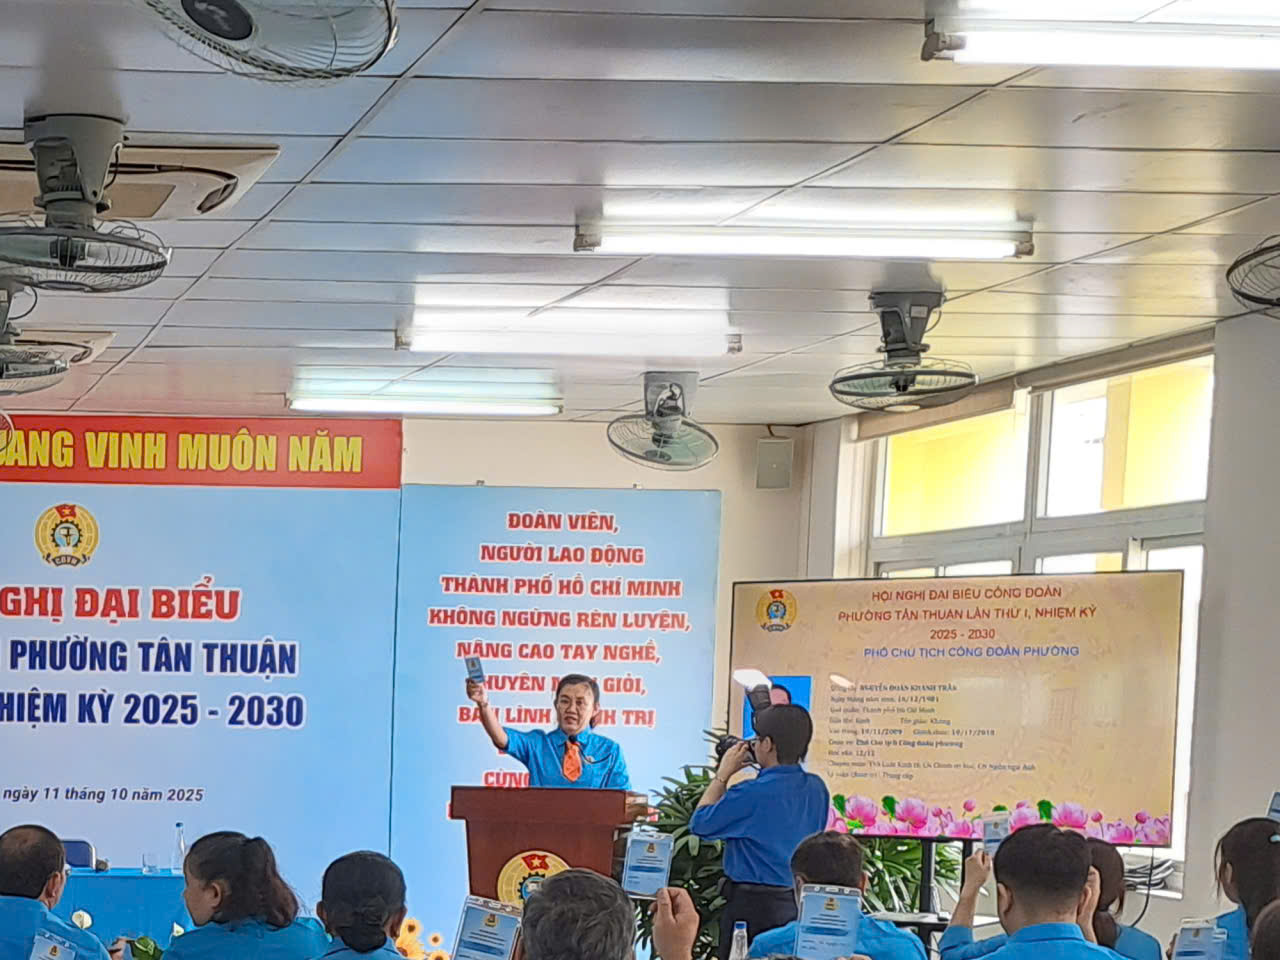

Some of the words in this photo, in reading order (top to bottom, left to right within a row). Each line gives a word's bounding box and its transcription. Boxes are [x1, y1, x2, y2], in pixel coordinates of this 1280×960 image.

[85, 432, 165, 468] VINH
[178, 426, 277, 471] MUÔN
[288, 429, 362, 472] NĂM
[509, 511, 562, 529] ĐOÀN
[569, 513, 619, 533] VIÊN,
[481, 543, 541, 562] NGƯỜI
[548, 546, 585, 562] LAO
[591, 546, 644, 567] ĐỘNG
[441, 575, 508, 593] THÀNH
[514, 574, 552, 594] PHỐ
[558, 574, 583, 594] HỒ
[591, 578, 621, 595] CHÍ
[627, 581, 681, 596] MINH
[896, 590, 925, 602] NGHỊ
[985, 588, 1021, 599] CÔNG
[1026, 585, 1061, 597] ĐOÀN
[75, 588, 140, 624] ĐẠI
[151, 575, 240, 621] BIỂU
[429, 607, 495, 625] KHÔNG
[502, 608, 570, 626] NGỪNG
[577, 610, 616, 628] RÈN
[622, 612, 690, 632] LUYỆN,
[1035, 606, 1075, 619] NHIỆM
[930, 629, 957, 640] 2025
[968, 629, 995, 639] 2030
[10, 634, 127, 673] PHƯỜNG
[137, 635, 193, 673] TÂN
[202, 638, 296, 677] THUẬN
[457, 640, 512, 658] NÂNG
[518, 644, 554, 659] CAO
[561, 645, 598, 660] TAY
[603, 640, 660, 663] NGHỀ,
[920, 647, 945, 658] TỊCH
[948, 645, 983, 657] CÔNG
[482, 673, 545, 691] HUYÊN
[604, 673, 646, 695] GIỎI,
[77, 689, 112, 725] KỲ
[124, 695, 198, 725] 2025
[228, 696, 305, 727] 2030
[506, 705, 551, 723] LĨNH
[623, 710, 655, 728] TRỊ
[3, 786, 38, 802] ngày
[44, 788, 58, 799] 11
[65, 787, 104, 802] tháng
[111, 789, 127, 800] 10
[132, 788, 162, 800] năm
[167, 789, 204, 801] 2025
